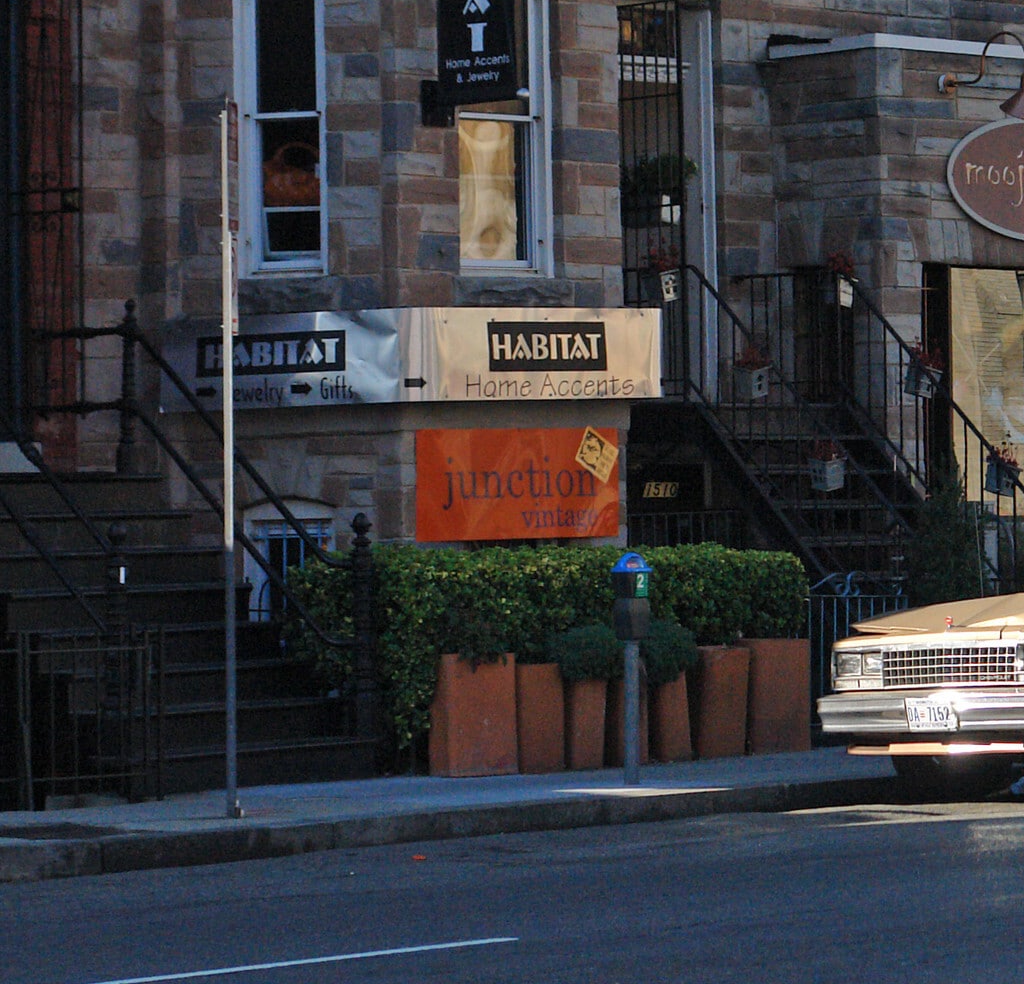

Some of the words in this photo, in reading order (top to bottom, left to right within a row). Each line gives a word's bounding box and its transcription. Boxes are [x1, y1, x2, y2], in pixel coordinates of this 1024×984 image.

[445, 58, 471, 69] Home
[474, 54, 510, 66] Accents
[467, 70, 500, 82] Jewelry
[204, 337, 340, 370] HABITAT
[491, 332, 602, 361] HABITAT
[233, 377, 285, 406] ewelry
[320, 377, 354, 401] Gifts
[465, 374, 532, 398] Home
[539, 373, 636, 397] Accents
[443, 456, 598, 510] junction
[645, 482, 678, 497] 1510
[521, 503, 599, 532] vintage
[636, 573, 645, 589] 2
[926, 706, 951, 722] 7152
